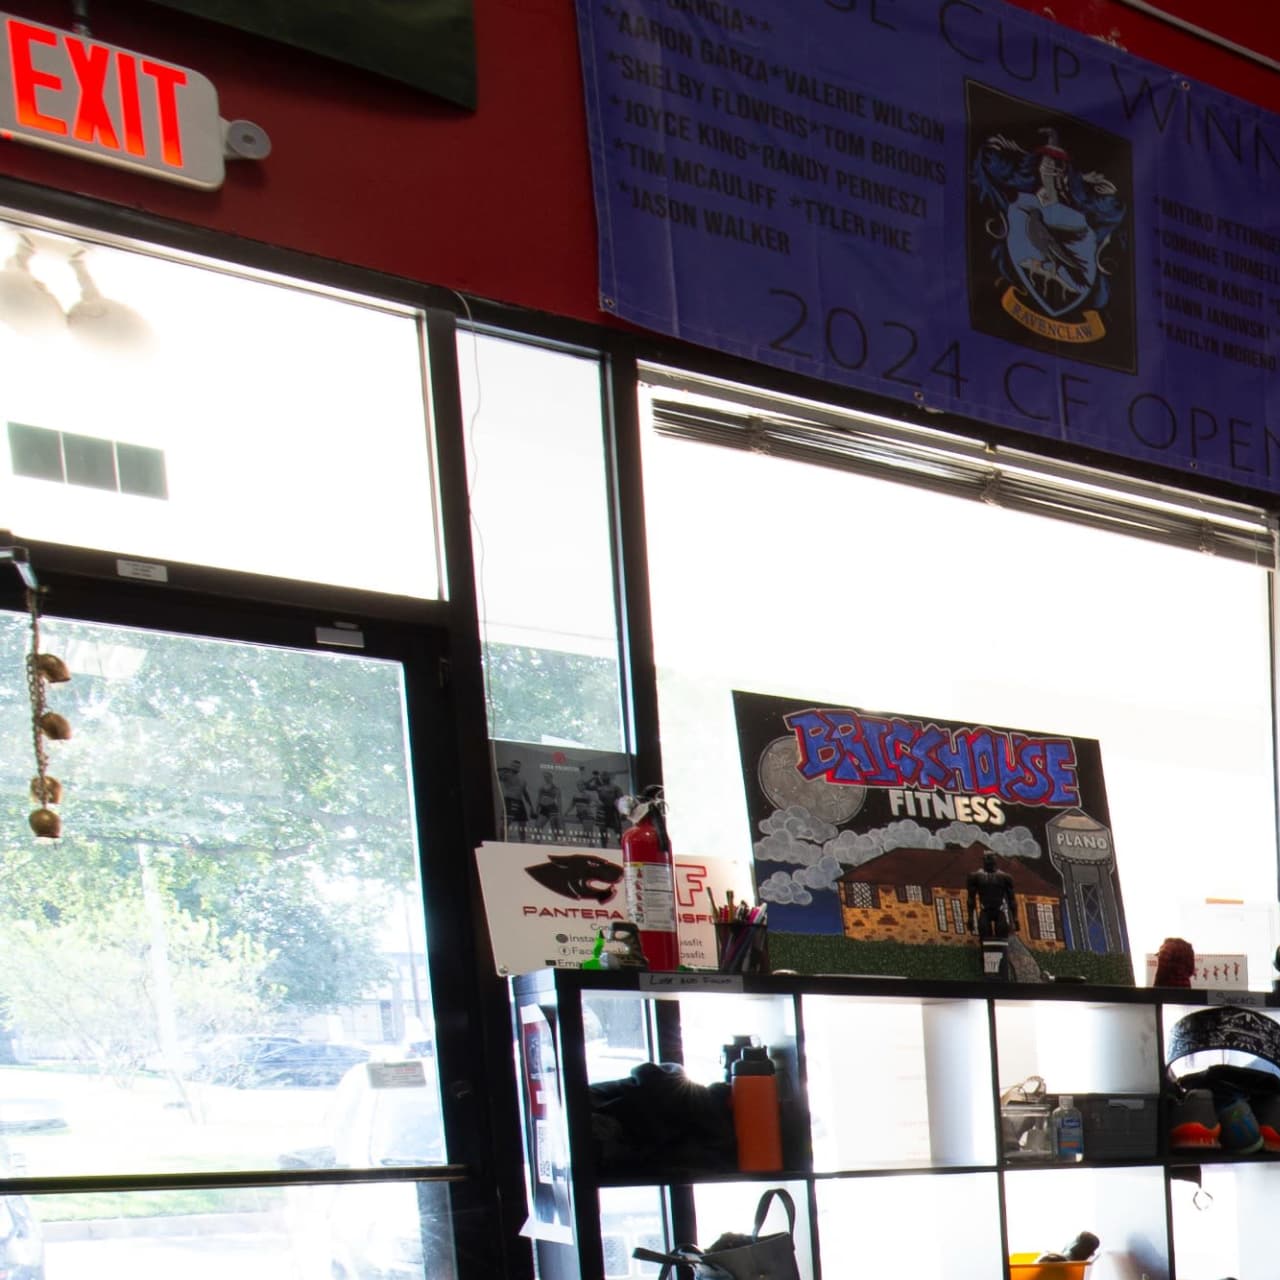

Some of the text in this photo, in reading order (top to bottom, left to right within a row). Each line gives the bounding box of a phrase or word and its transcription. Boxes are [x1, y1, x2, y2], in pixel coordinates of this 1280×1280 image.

[618, 10, 692, 58] AARON
[872, 97, 945, 145] WILSON
[940, 0, 1080, 94] CUP
[8, 20, 187, 168] EXIT
[621, 55, 704, 99] SHELBY
[872, 140, 946, 184] BROOKS
[704, 210, 790, 256] WALKER
[871, 221, 912, 254] PIKE
[1012, 303, 1092, 339] RAVENCLAW
[768, 289, 967, 398] 2024
[1003, 361, 1090, 428] CF
[783, 709, 1082, 807] BRICKHOUSE
[889, 788, 1006, 825] FITNESS
[1056, 832, 1108, 850] PLANO
[522, 905, 624, 921] PANTERA
